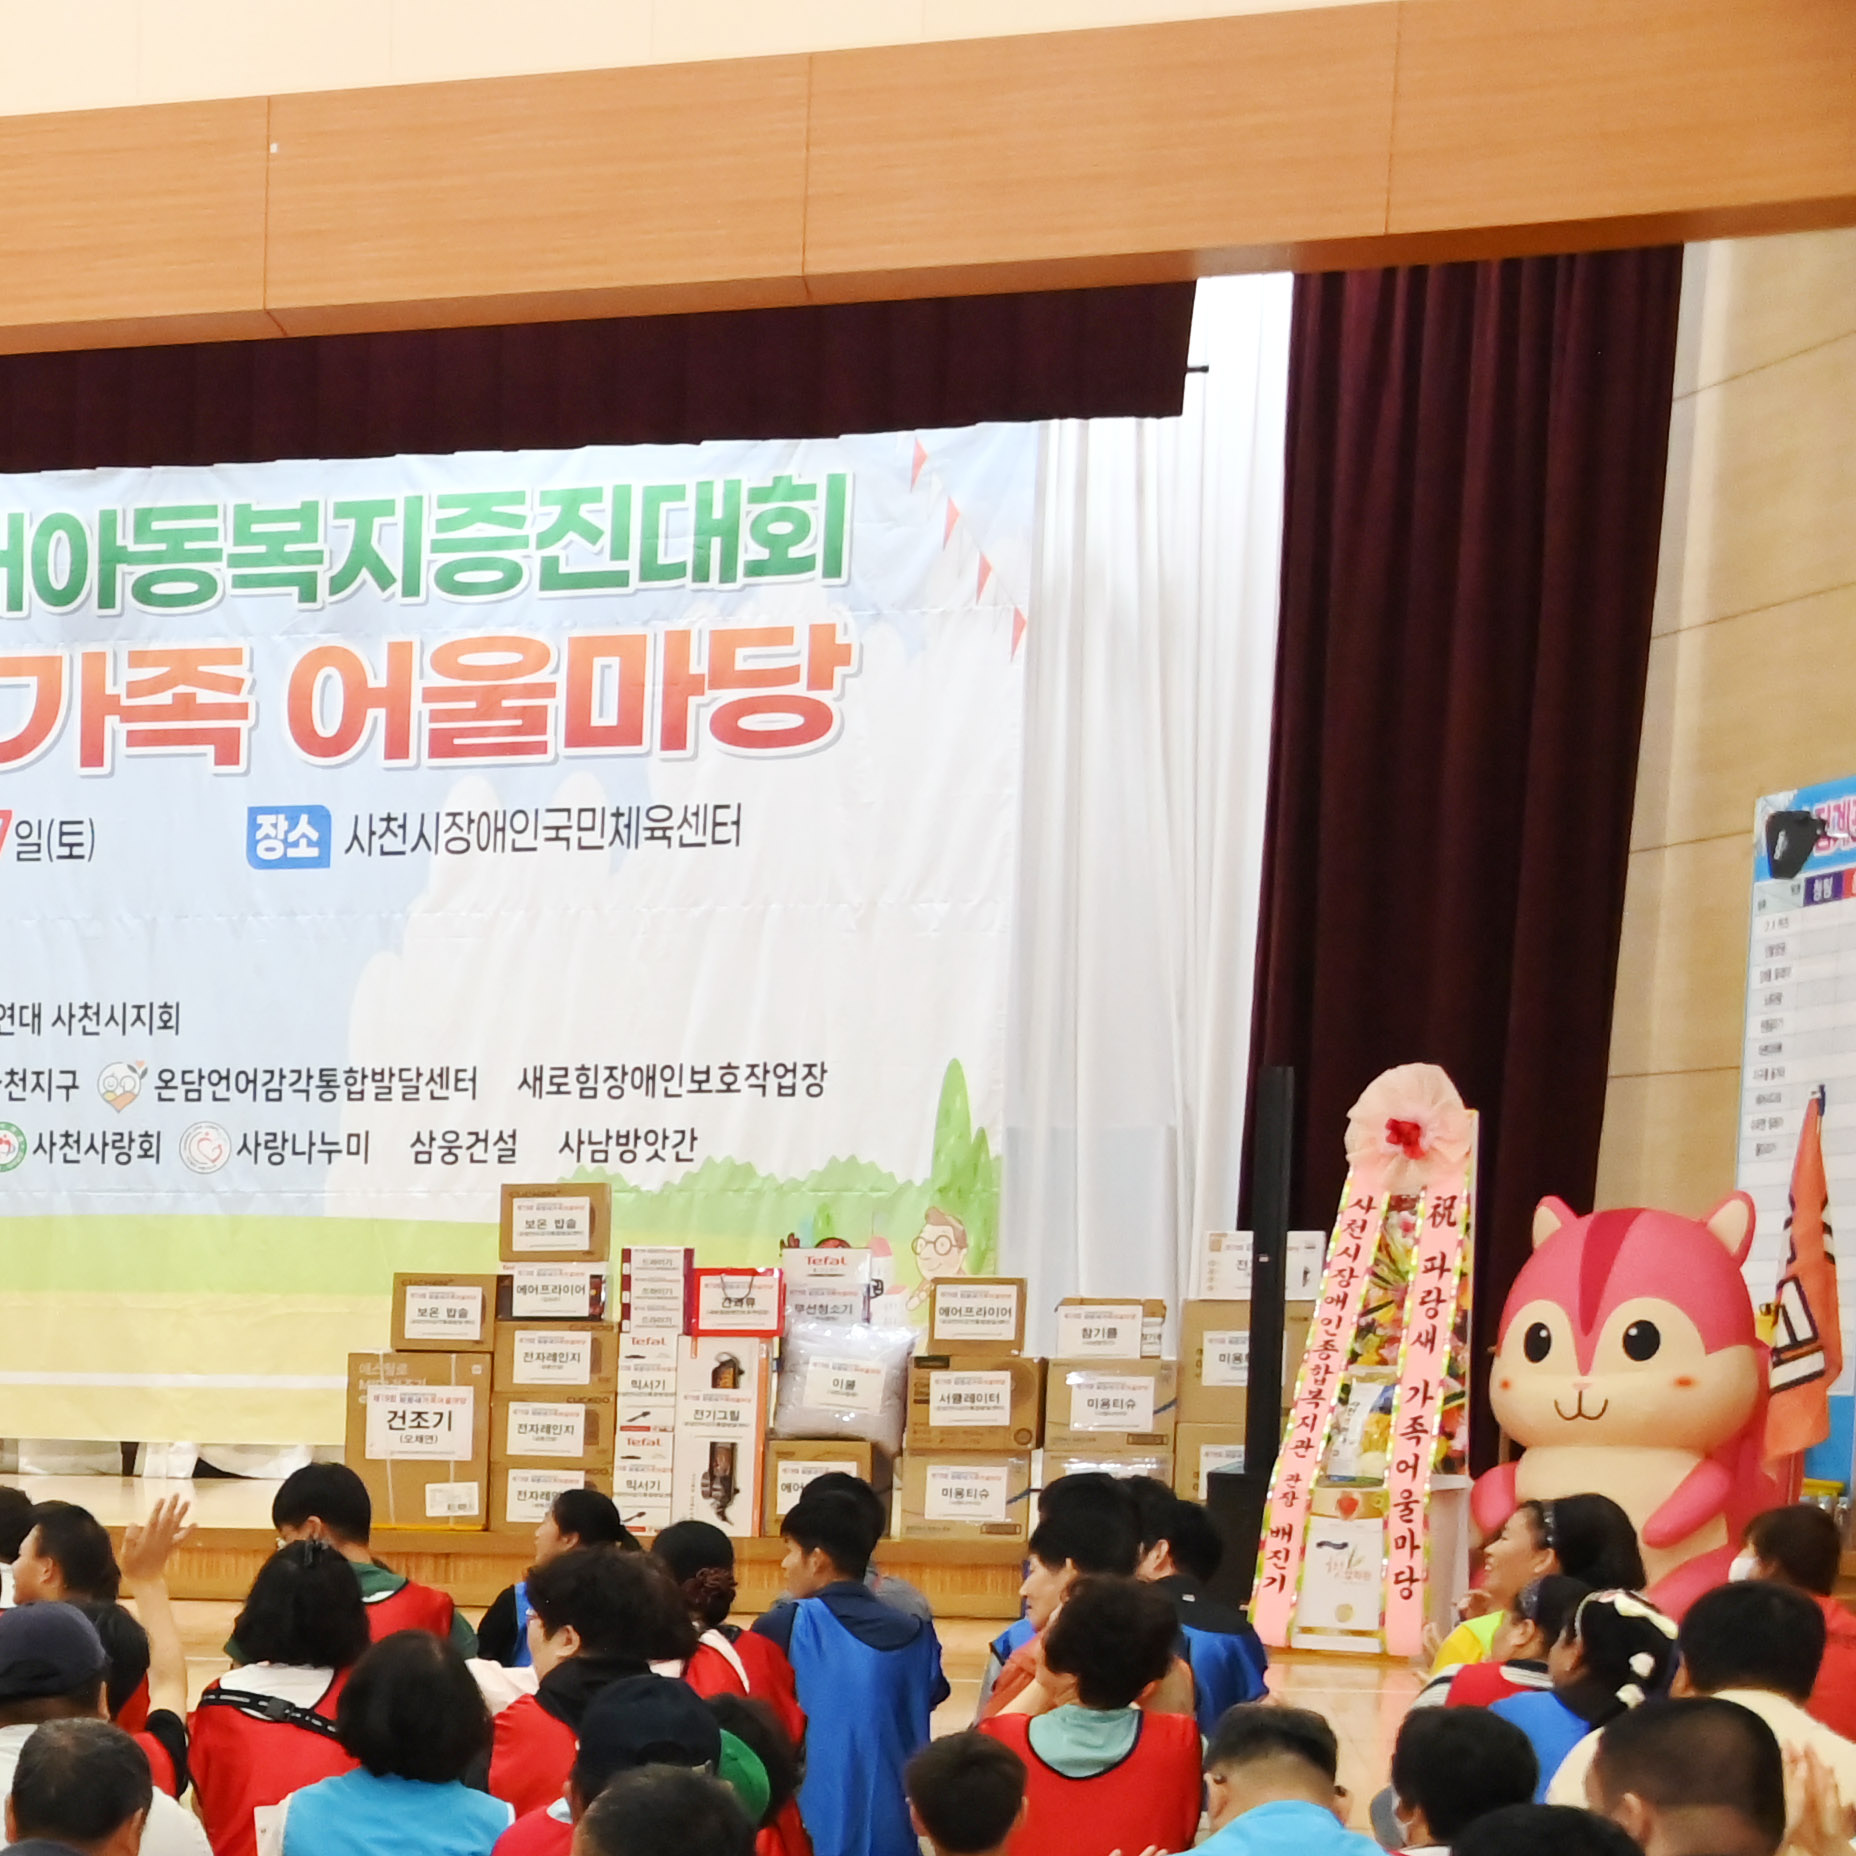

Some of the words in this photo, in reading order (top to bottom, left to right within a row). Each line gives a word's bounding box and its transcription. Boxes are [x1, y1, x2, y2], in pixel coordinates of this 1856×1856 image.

[288, 623, 853, 760] 어울마당
[256, 815, 320, 858] 장소
[344, 802, 742, 856] 사천시장애인국민체육센터
[52, 1002, 180, 1037] 사천시지회
[153, 1064, 477, 1103] 온담언어감각통합발달센터
[518, 1061, 828, 1100] 새로힘장애인보호작업장
[33, 1129, 161, 1164] 사천사랑회
[237, 1130, 369, 1166] 사랑나누미
[410, 1128, 517, 1164] 삼웅건설
[558, 1127, 697, 1164] 사남방앗간
[1426, 1195, 1458, 1228] 祝
[805, 1256, 847, 1266] Tefal
[517, 1285, 585, 1295] 에어프라이어
[795, 1304, 852, 1315] 무선청소기
[939, 1307, 1011, 1317] 에어프라이어
[1410, 1252, 1453, 1355] 파랑새
[1082, 1328, 1117, 1339] 참기름
[1292, 1195, 1378, 1458] 사천시장애인종합복지관
[631, 1337, 665, 1345] Tefal
[524, 1352, 580, 1363] 전자레인지
[1219, 1352, 1248, 1365] 미용
[631, 1380, 665, 1390] 믹서기
[1087, 1398, 1136, 1409] 미용티슈
[387, 1410, 451, 1431] 건조기
[694, 1410, 739, 1421] 전기그릴
[518, 1424, 574, 1435] 전자레인지
[627, 1437, 661, 1447] Tefal
[626, 1480, 660, 1491] 믹서기
[942, 1488, 989, 1499] 미용티슈
[1278, 1473, 1302, 1509] 관장
[1262, 1523, 1294, 1595] 배진기
